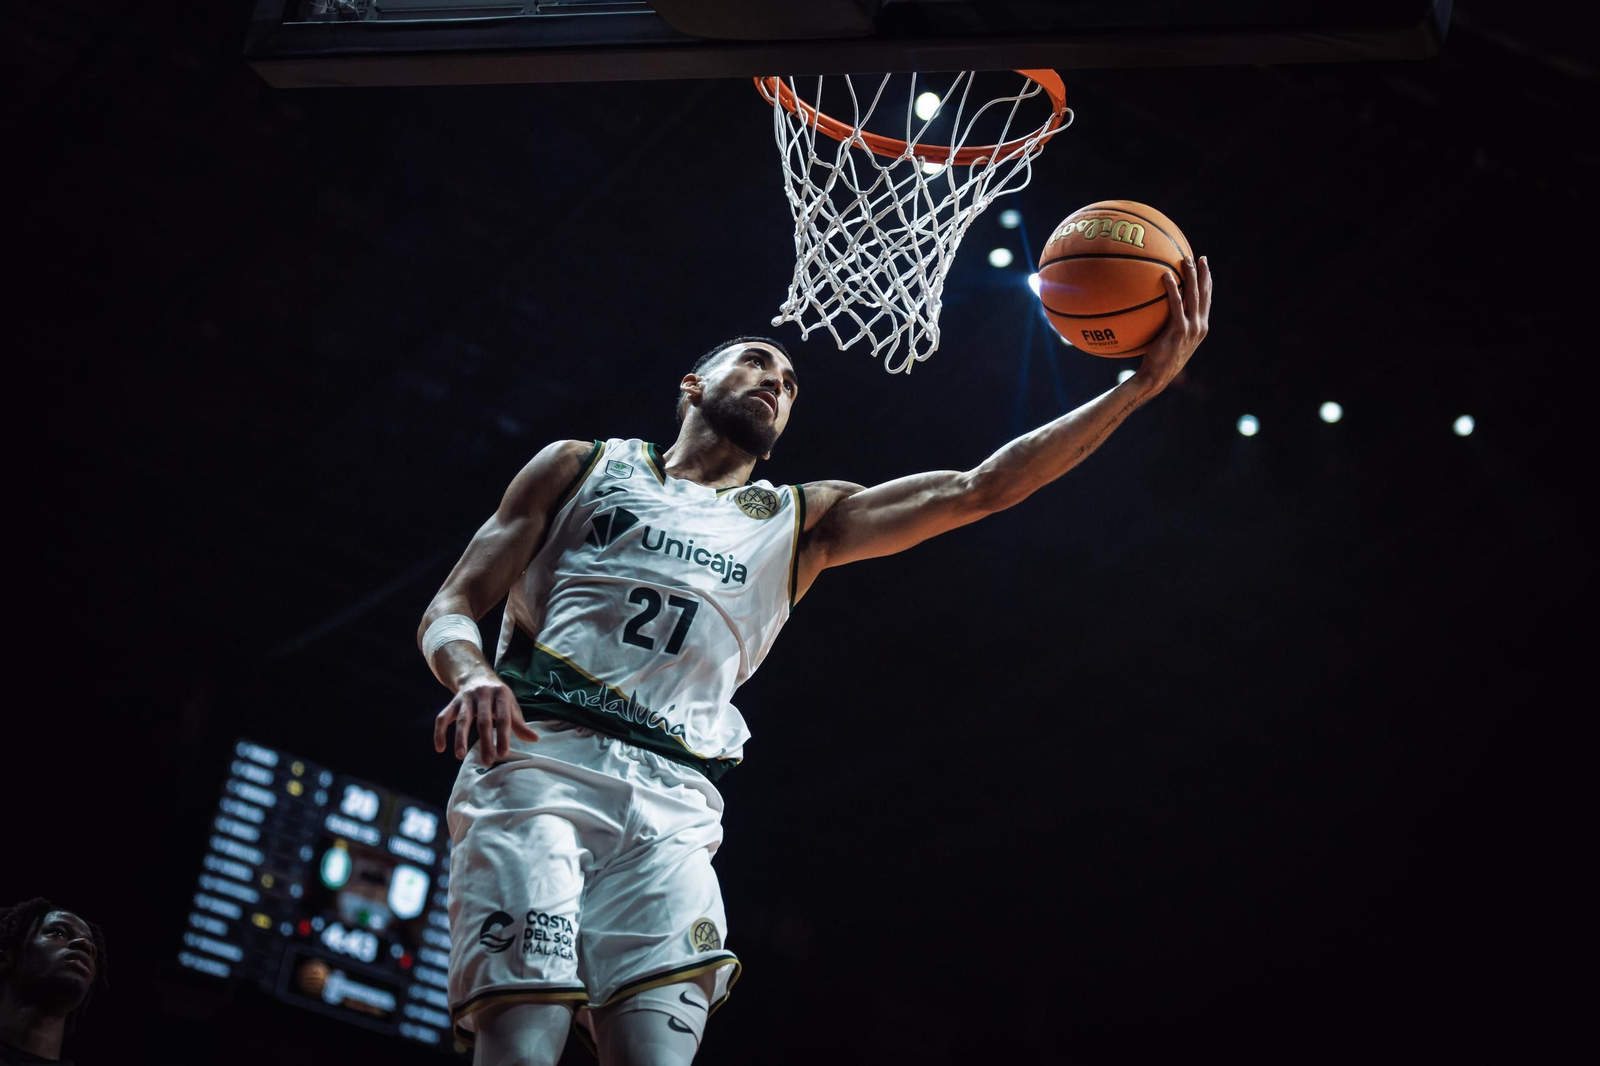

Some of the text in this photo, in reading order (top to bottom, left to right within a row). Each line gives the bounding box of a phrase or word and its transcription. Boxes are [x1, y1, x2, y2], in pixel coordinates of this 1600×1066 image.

[1081, 328, 1116, 342] FIBA
[641, 526, 748, 586] Unicaja
[622, 586, 699, 656] 27
[525, 910, 574, 935] COSTA
[523, 928, 573, 948] DEL SOL
[522, 941, 574, 961] MÁLAGA
